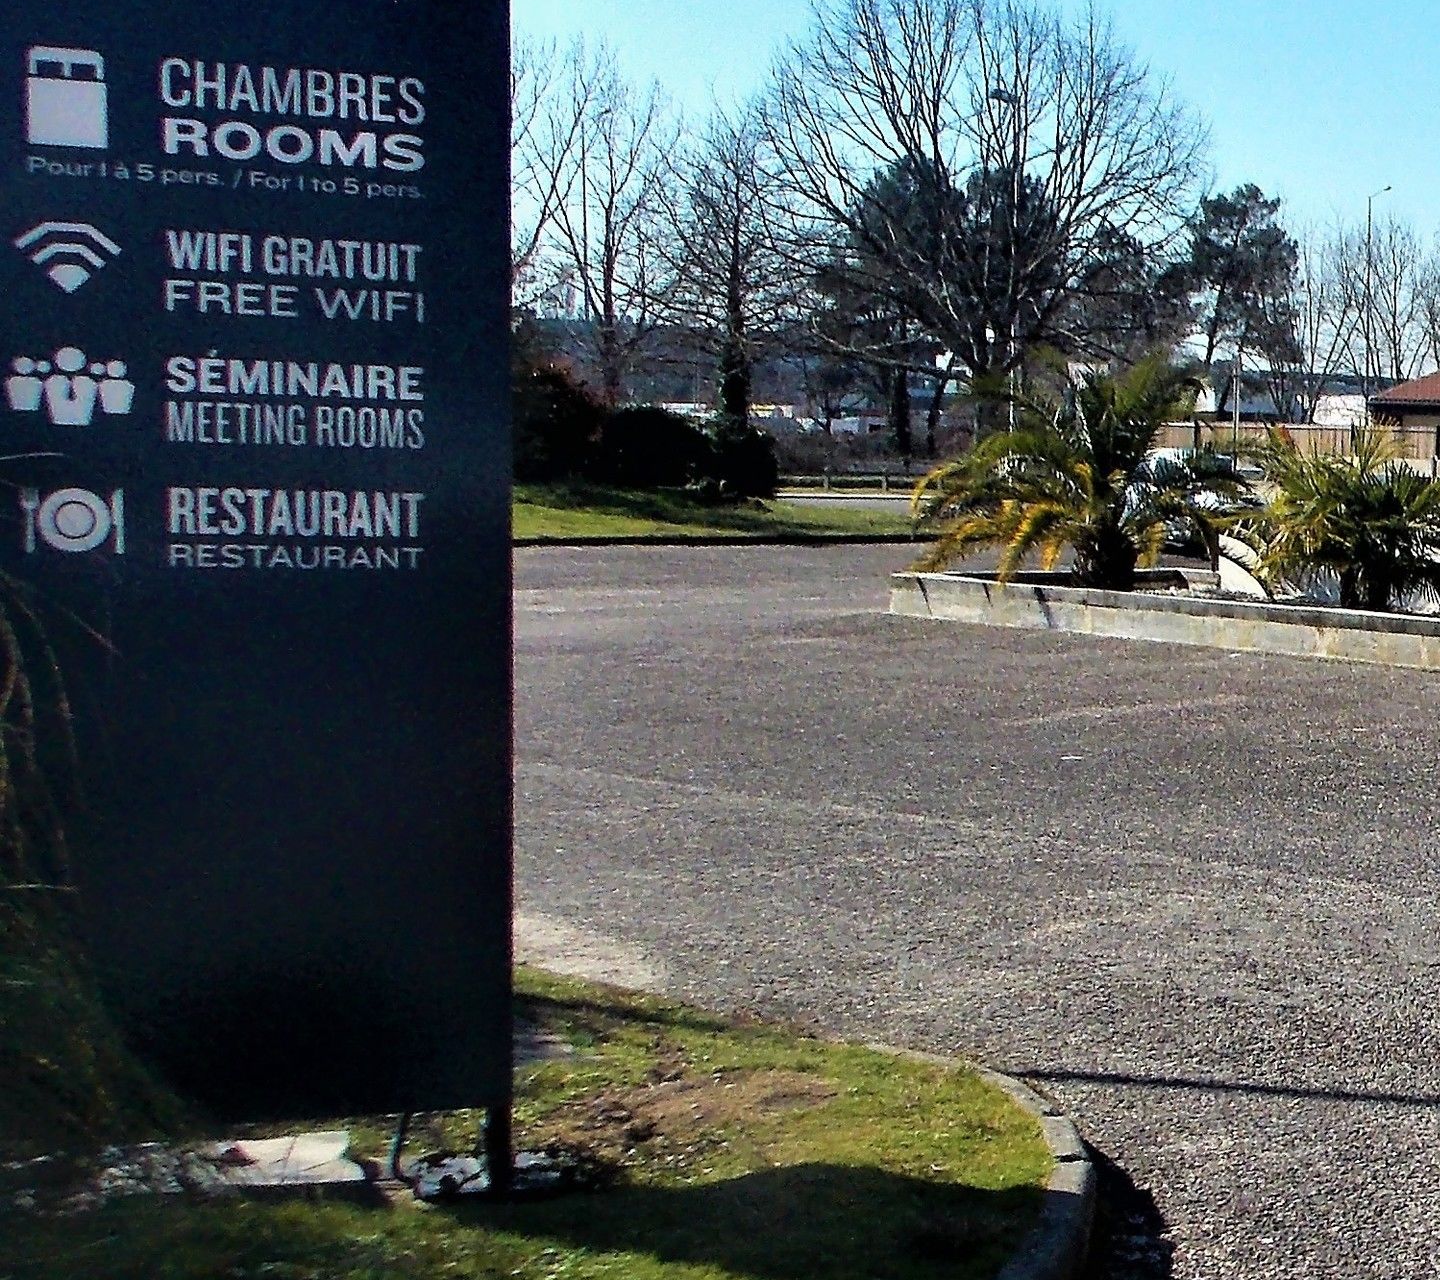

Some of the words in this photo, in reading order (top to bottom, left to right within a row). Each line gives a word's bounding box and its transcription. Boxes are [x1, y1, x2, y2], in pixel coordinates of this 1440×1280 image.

[161, 56, 426, 125] CHAMBRES
[162, 117, 426, 173] ROOMS
[28, 155, 92, 177] Pour
[136, 163, 155, 182] 5
[161, 168, 225, 187] pers.
[249, 171, 291, 192] For
[311, 177, 337, 194] to
[343, 177, 360, 195] 5
[366, 182, 426, 199] pers.
[166, 230, 252, 273] WIFI
[264, 236, 423, 283] GRATUIT
[166, 280, 299, 318] FREE
[315, 288, 426, 323] WIFI
[167, 349, 425, 401] SÉMINAIRE
[168, 401, 306, 446] MEETING
[316, 407, 426, 450] ROOMS
[168, 487, 426, 538] RESTAURANT
[168, 544, 426, 571] RESTAURANT
